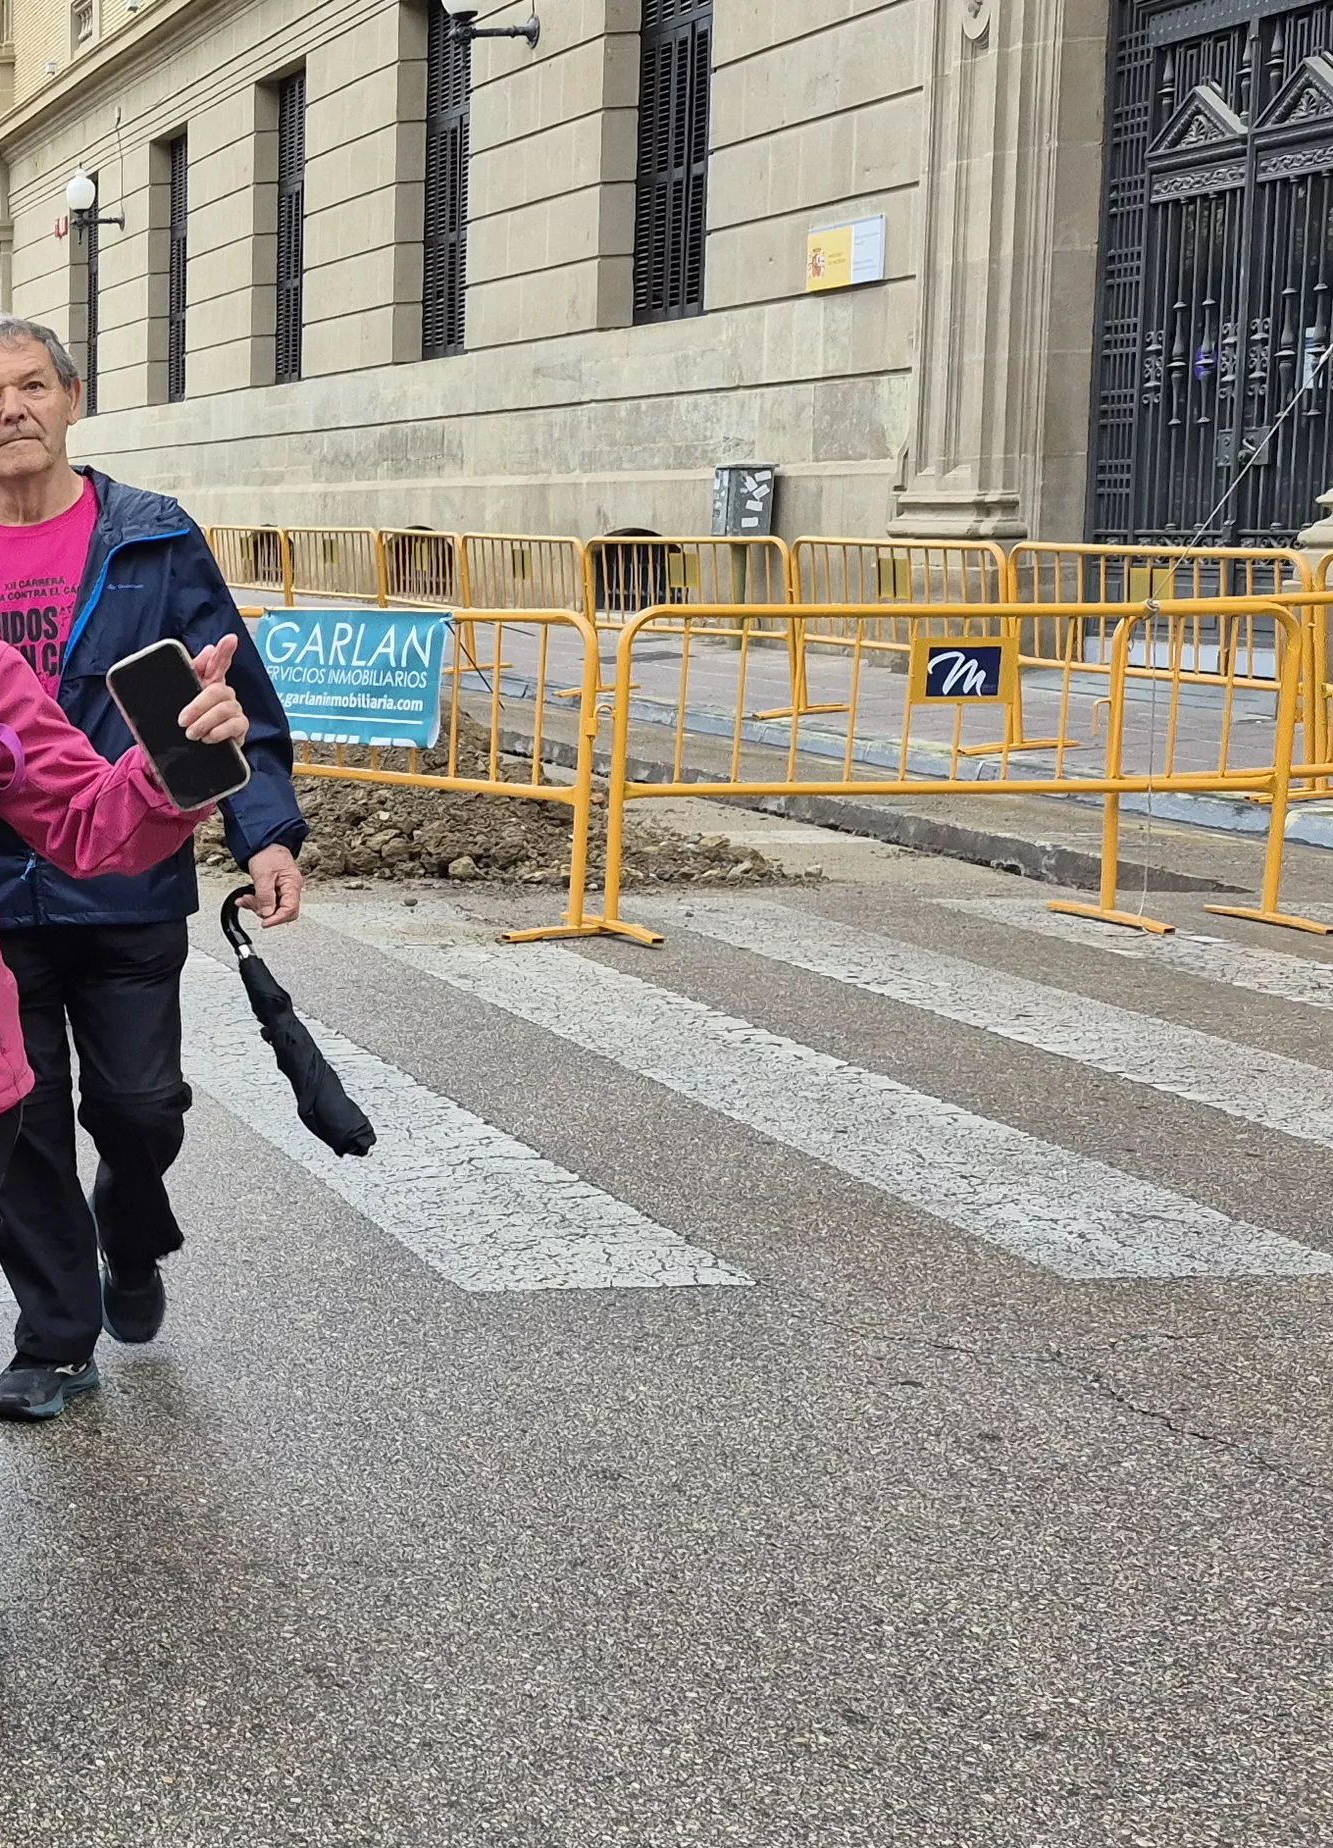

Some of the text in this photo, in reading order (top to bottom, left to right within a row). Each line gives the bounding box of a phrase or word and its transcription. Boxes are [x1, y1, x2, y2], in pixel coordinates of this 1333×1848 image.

[8, 589, 47, 601] CONTRA
[50, 587, 62, 596] EL
[19, 578, 65, 589] CARRERA
[265, 621, 435, 669] GARLAN
[266, 665, 427, 689] ERVICIOS INMOBILIARIOS
[277, 691, 424, 712] .garlaninmobiliaria.com
